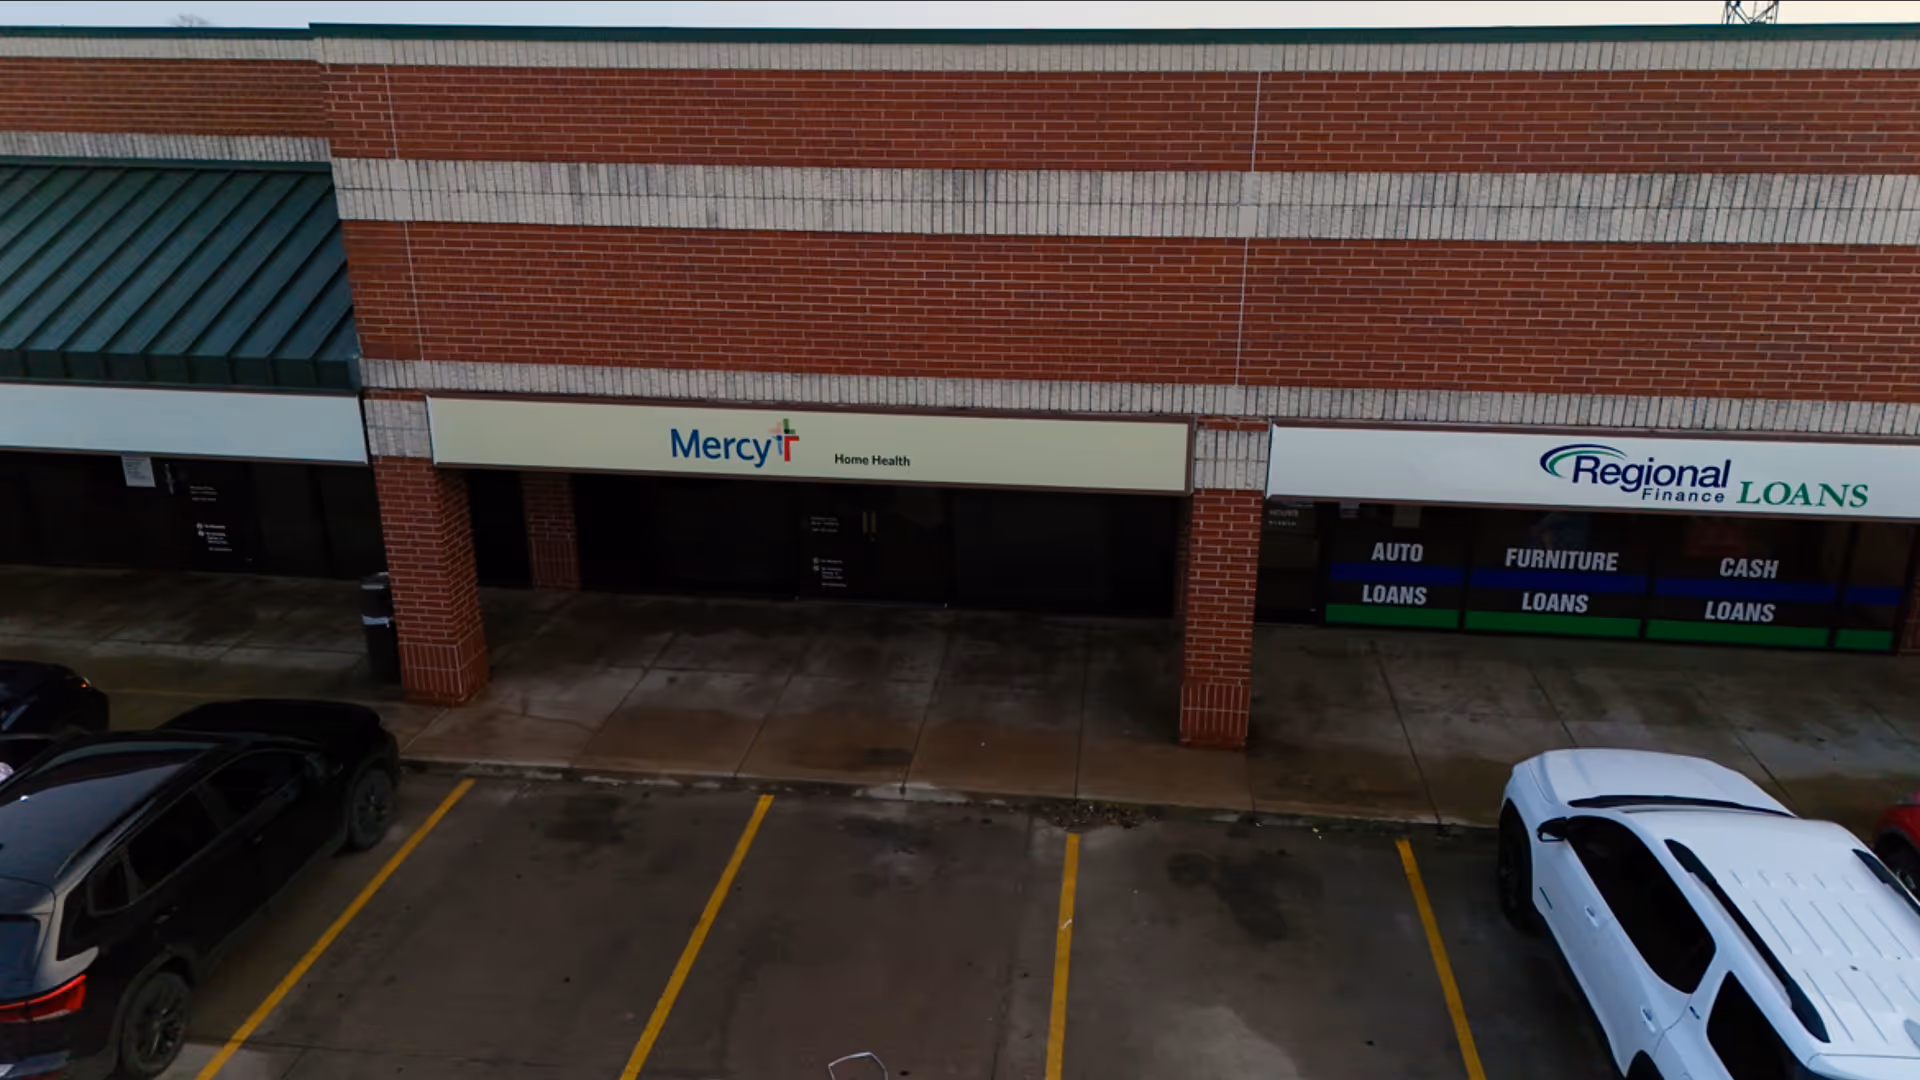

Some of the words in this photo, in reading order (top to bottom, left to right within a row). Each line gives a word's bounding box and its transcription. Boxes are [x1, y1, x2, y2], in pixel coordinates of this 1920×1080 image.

[670, 428, 772, 468] Mercy
[834, 453, 869, 465] Home
[872, 454, 911, 467] Health
[1571, 455, 1732, 493] Regional
[1641, 487, 1725, 503] Finance
[1735, 480, 1869, 508] LOANS
[1371, 542, 1424, 563] AUTO
[1505, 548, 1620, 572] FURNITURE
[1719, 557, 1779, 579] CASH
[1362, 584, 1428, 606] LOANS
[1521, 592, 1590, 614] LOANS
[1704, 601, 1777, 623] LOANS
